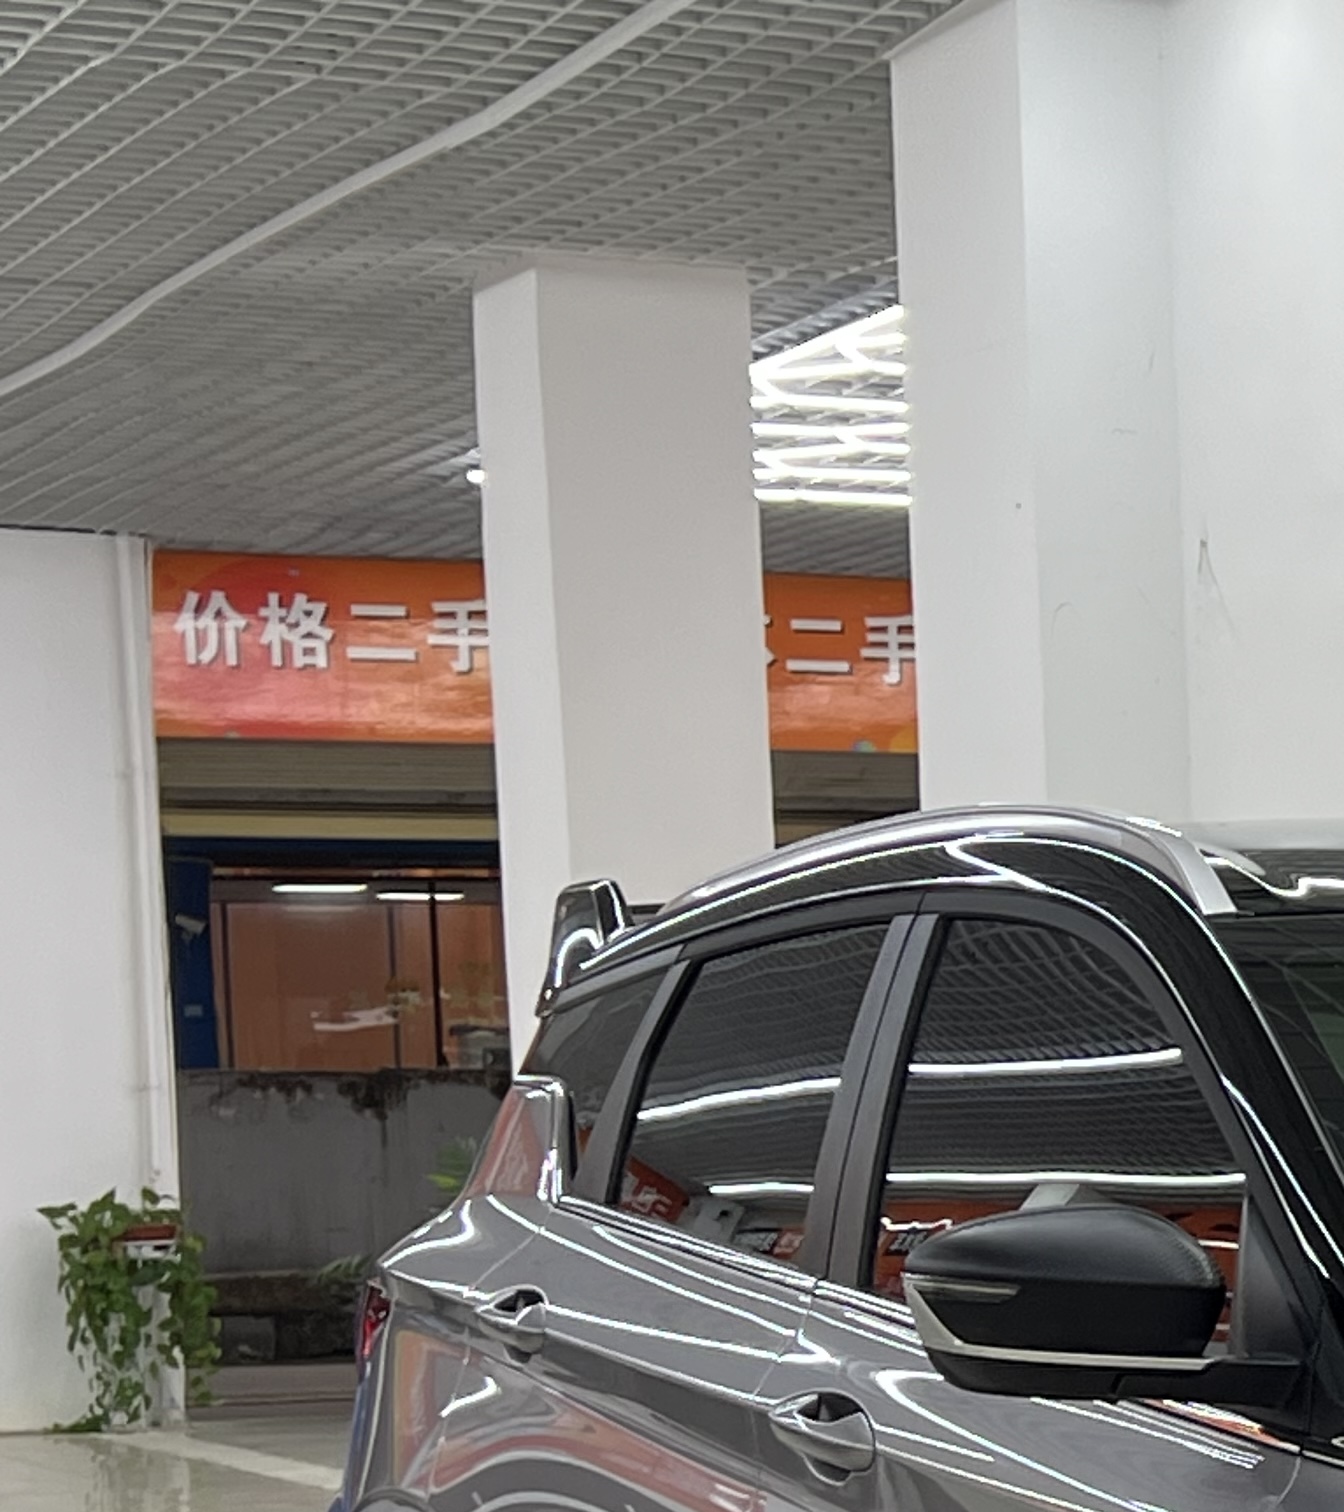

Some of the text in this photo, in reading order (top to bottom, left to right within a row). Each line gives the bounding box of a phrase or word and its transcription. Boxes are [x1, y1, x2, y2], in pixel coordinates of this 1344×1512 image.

[174, 590, 490, 673] 价格二手
[764, 615, 916, 684] 二手
